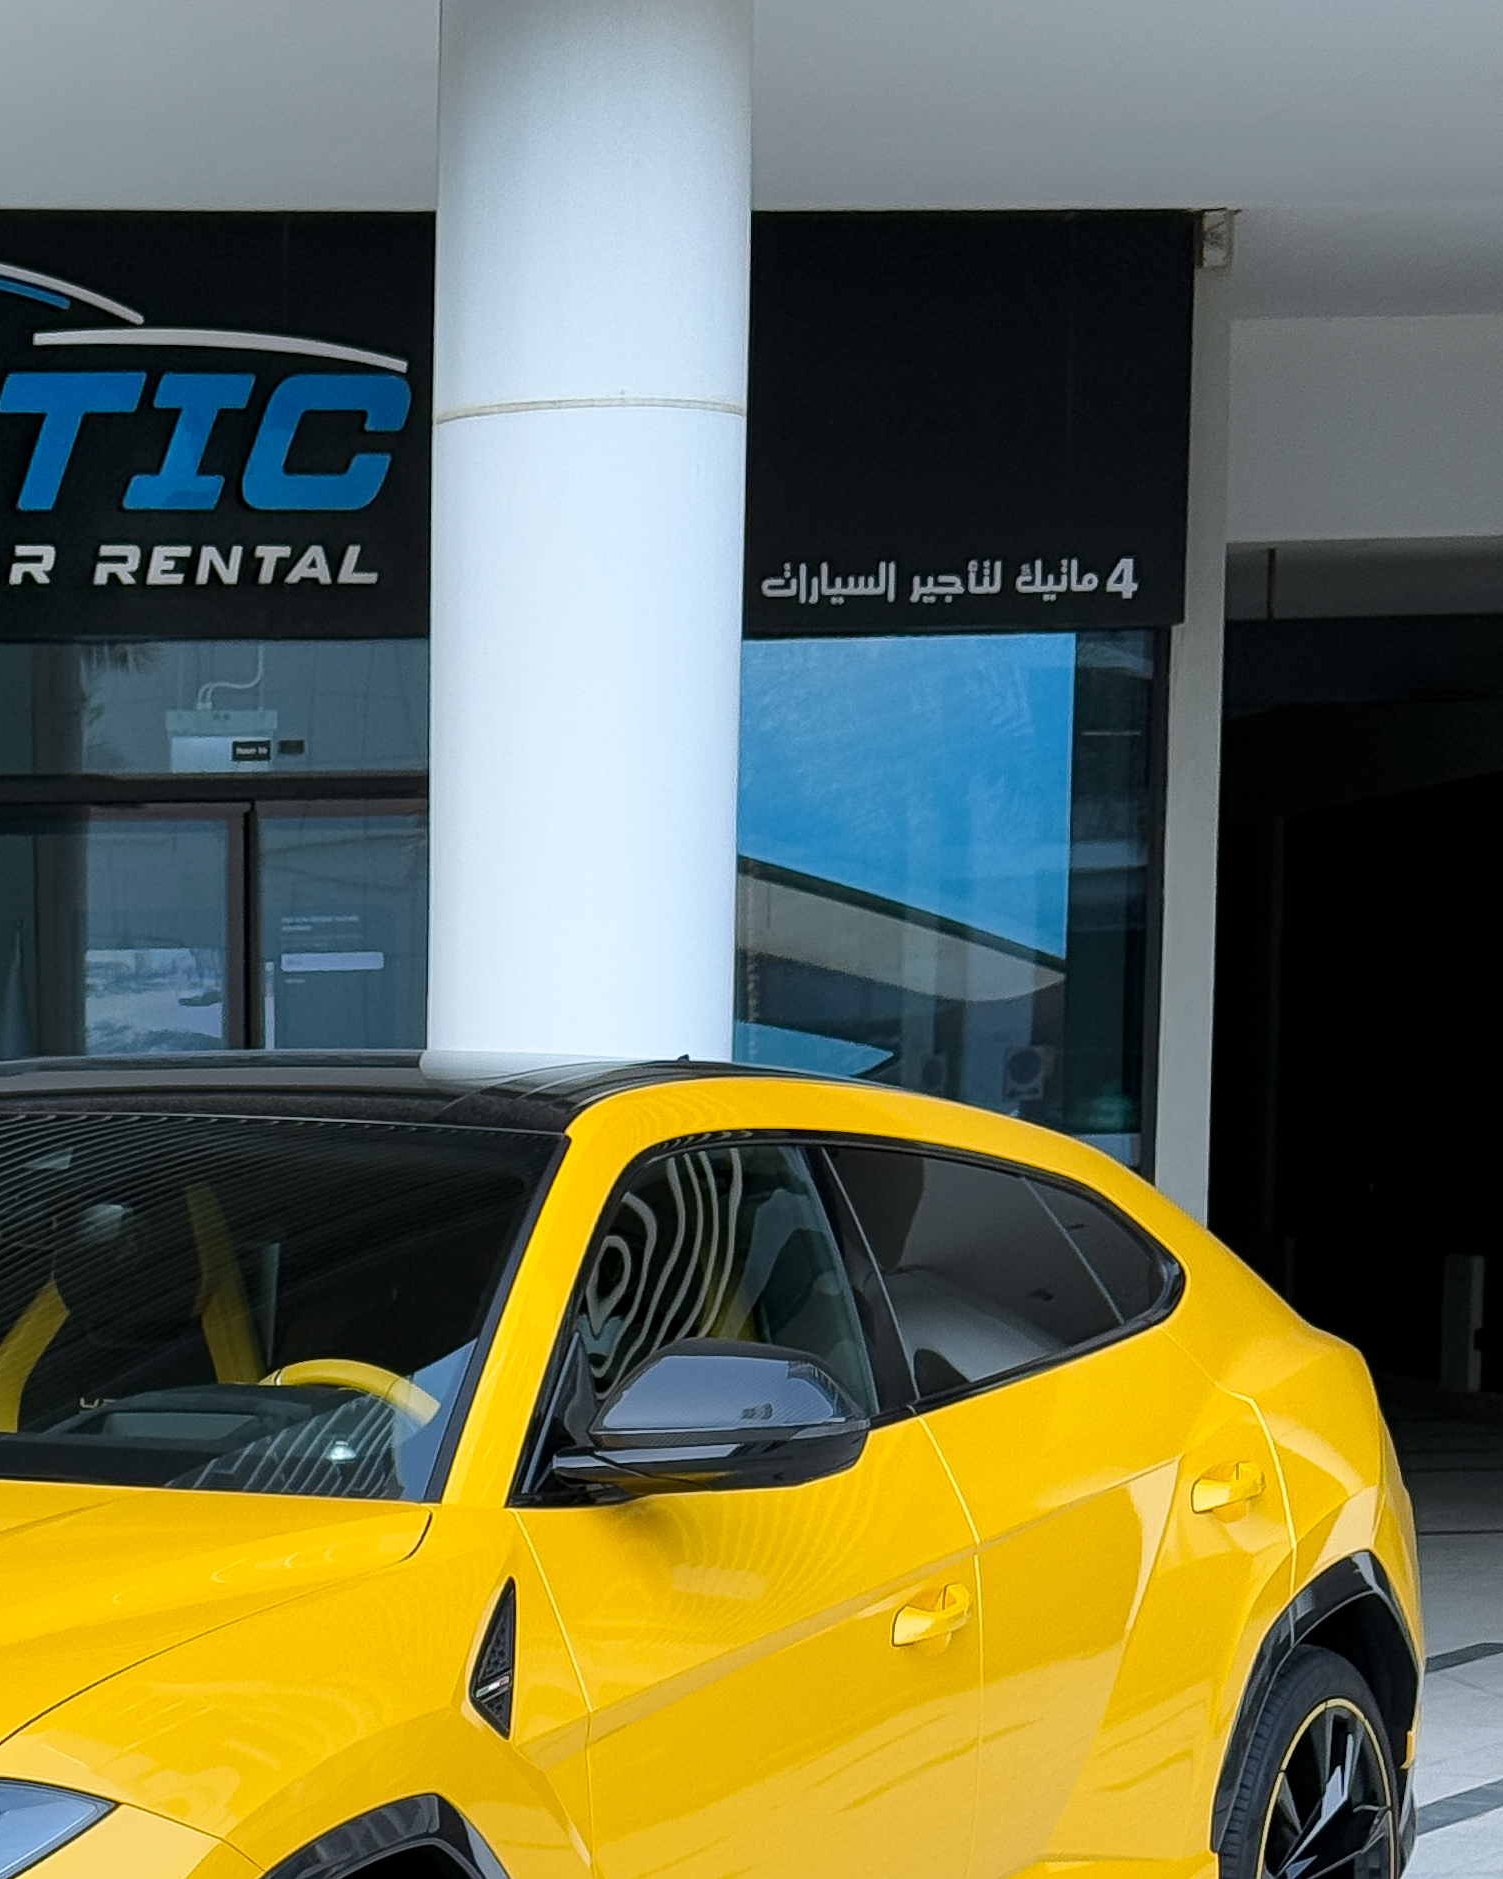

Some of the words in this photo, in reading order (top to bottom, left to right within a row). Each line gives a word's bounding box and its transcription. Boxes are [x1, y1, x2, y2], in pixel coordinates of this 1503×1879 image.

[92, 544, 379, 586] RENTAL
[760, 560, 897, 605] السيارات
[910, 558, 1003, 604] لتأجير
[1015, 557, 1100, 602] ماتيك
[1105, 557, 1139, 600] 4
